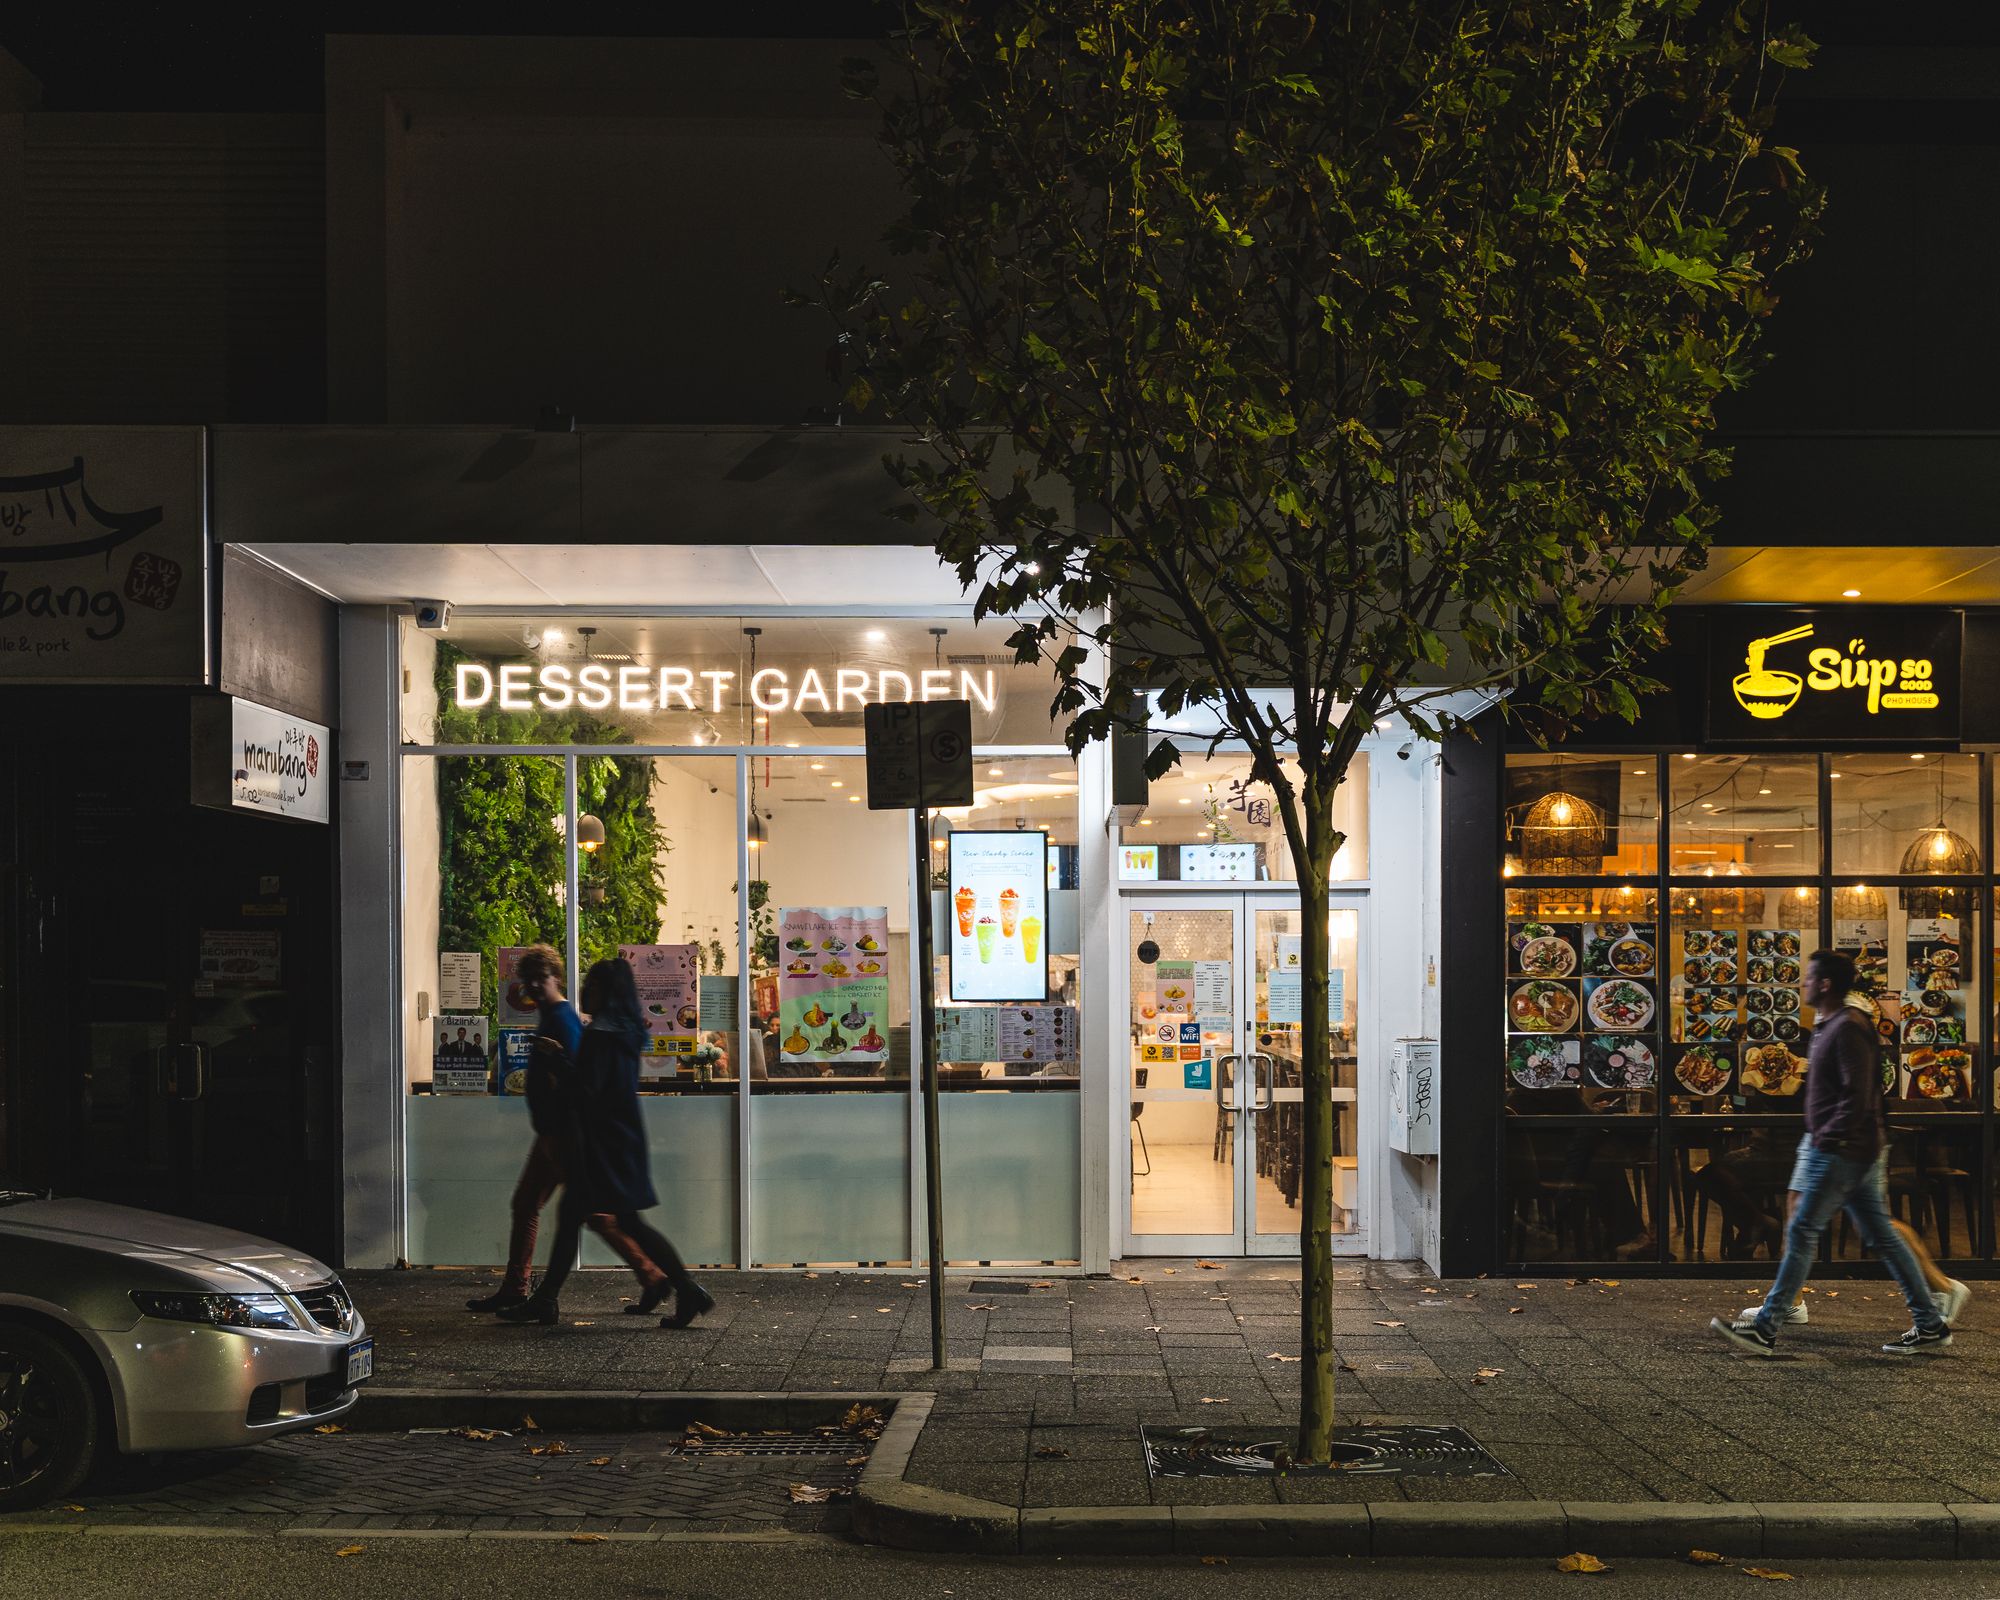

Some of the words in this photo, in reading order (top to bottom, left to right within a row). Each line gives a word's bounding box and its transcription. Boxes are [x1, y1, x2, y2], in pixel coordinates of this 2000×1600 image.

[36, 637, 70, 657] pork
[1900, 658, 1933, 680] SO
[455, 663, 736, 713] DESSERT
[749, 667, 996, 713] GARDEN
[1899, 679, 1934, 692] GOOD
[1886, 697, 1904, 705] PHO
[1905, 697, 1934, 705] HOUSE
[244, 739, 308, 797] marubang
[1226, 779, 1272, 828] 芋園
[1180, 1032, 1200, 1041] WiFi
